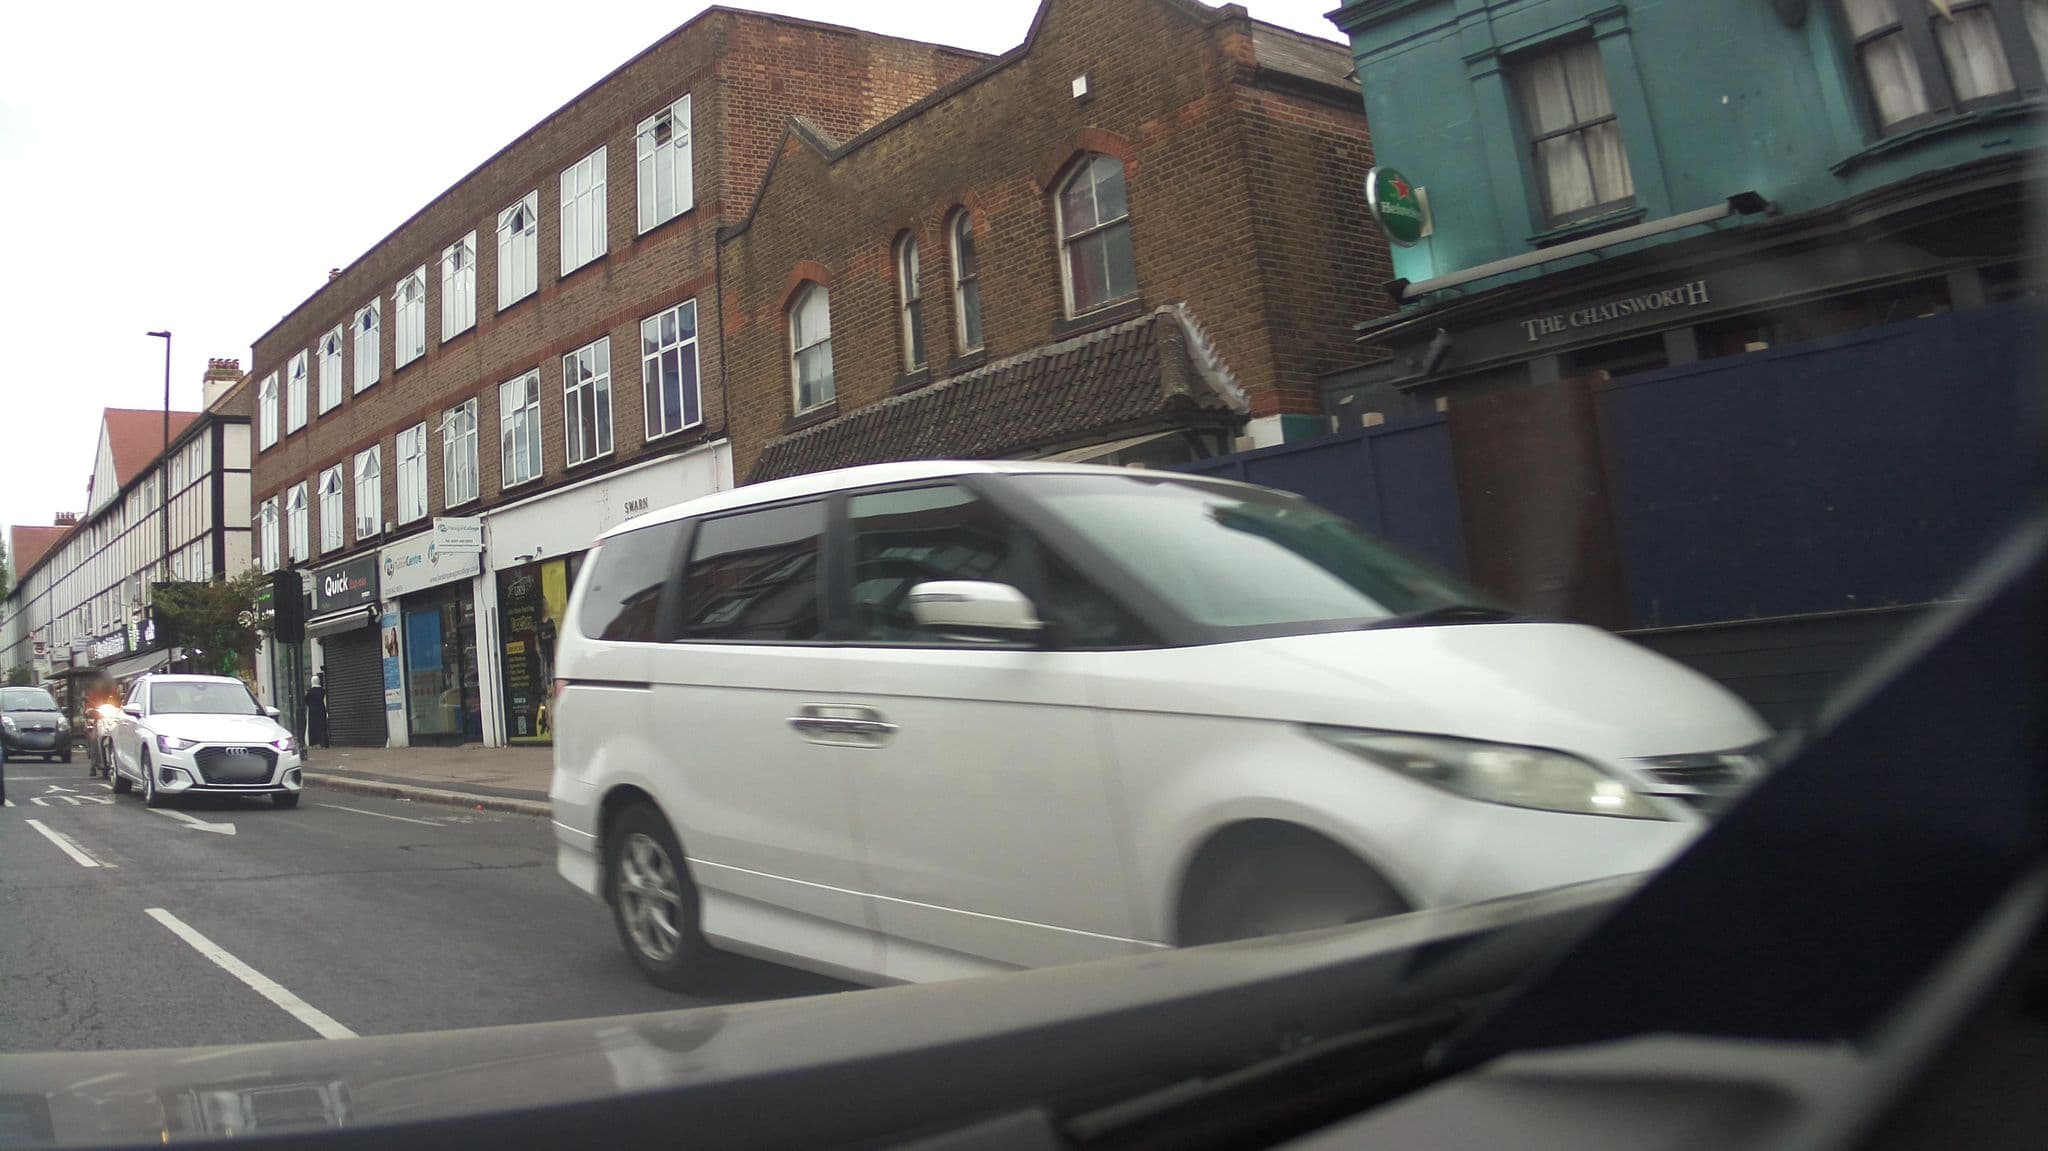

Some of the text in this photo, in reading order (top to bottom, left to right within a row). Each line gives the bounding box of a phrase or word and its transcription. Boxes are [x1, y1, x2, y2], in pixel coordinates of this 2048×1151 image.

[1520, 280, 1710, 342] THE CHATSWORTH
[325, 570, 349, 597] Quick
